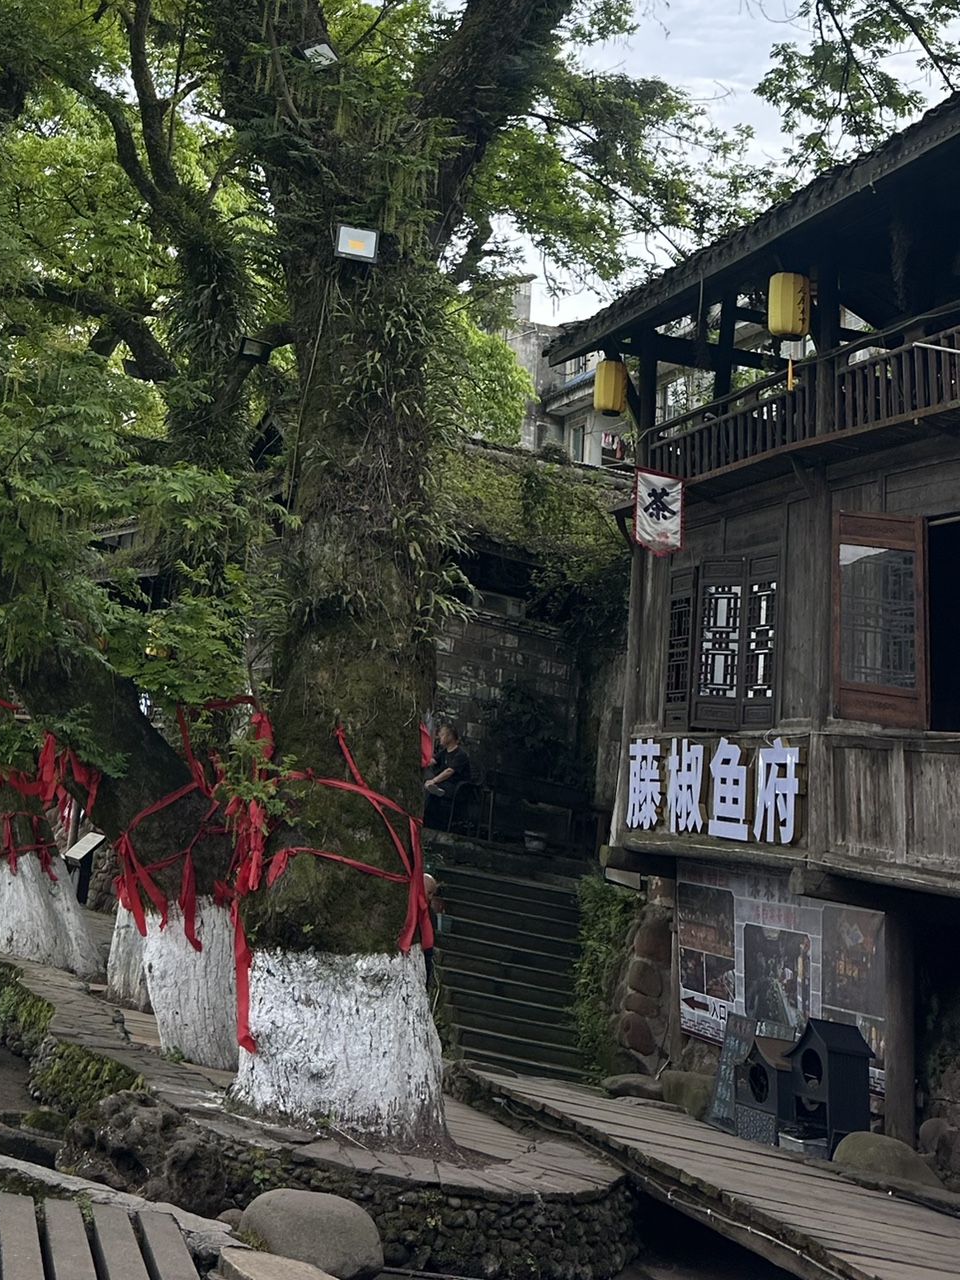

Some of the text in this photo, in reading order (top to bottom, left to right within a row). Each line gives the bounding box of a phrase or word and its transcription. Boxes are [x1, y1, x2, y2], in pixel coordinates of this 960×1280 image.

[643, 487, 676, 521] 茶
[627, 737, 800, 844] 藤椒鱼府
[711, 1002, 727, 1021] 入口
